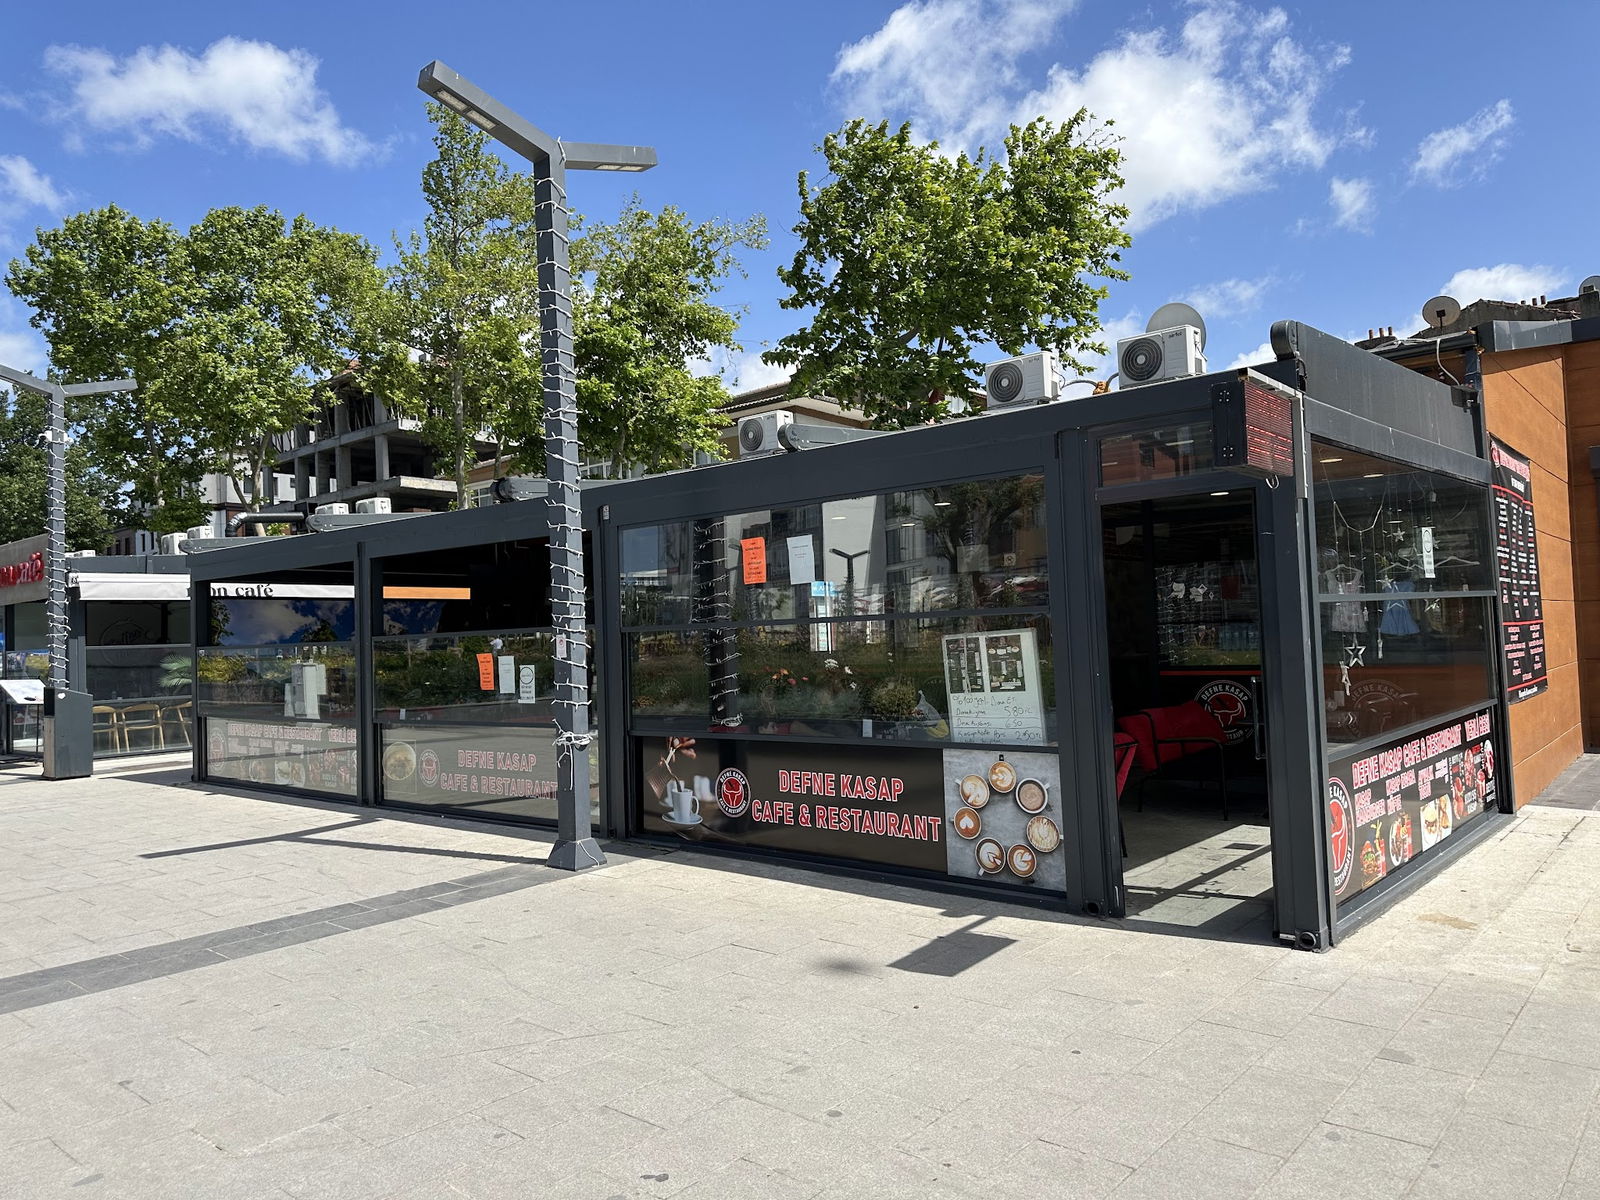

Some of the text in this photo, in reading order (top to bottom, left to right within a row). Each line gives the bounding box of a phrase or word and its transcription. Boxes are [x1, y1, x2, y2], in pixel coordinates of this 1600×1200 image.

[235, 583, 273, 597] café
[1201, 684, 1248, 701] DEFNE KASAP
[458, 750, 494, 769] DEFNE
[497, 753, 536, 772] KASAP
[1352, 754, 1379, 790] DEFNE
[1379, 746, 1402, 778] KASAP
[1403, 739, 1421, 768] CAFE
[1426, 724, 1462, 758] RESTAURANT
[440, 774, 558, 800] CAFE & RESTAURANT
[733, 771, 746, 785] KASAP
[778, 769, 904, 802] DEFNE KASAP
[751, 799, 942, 842] CAFE & RESTAURANT
